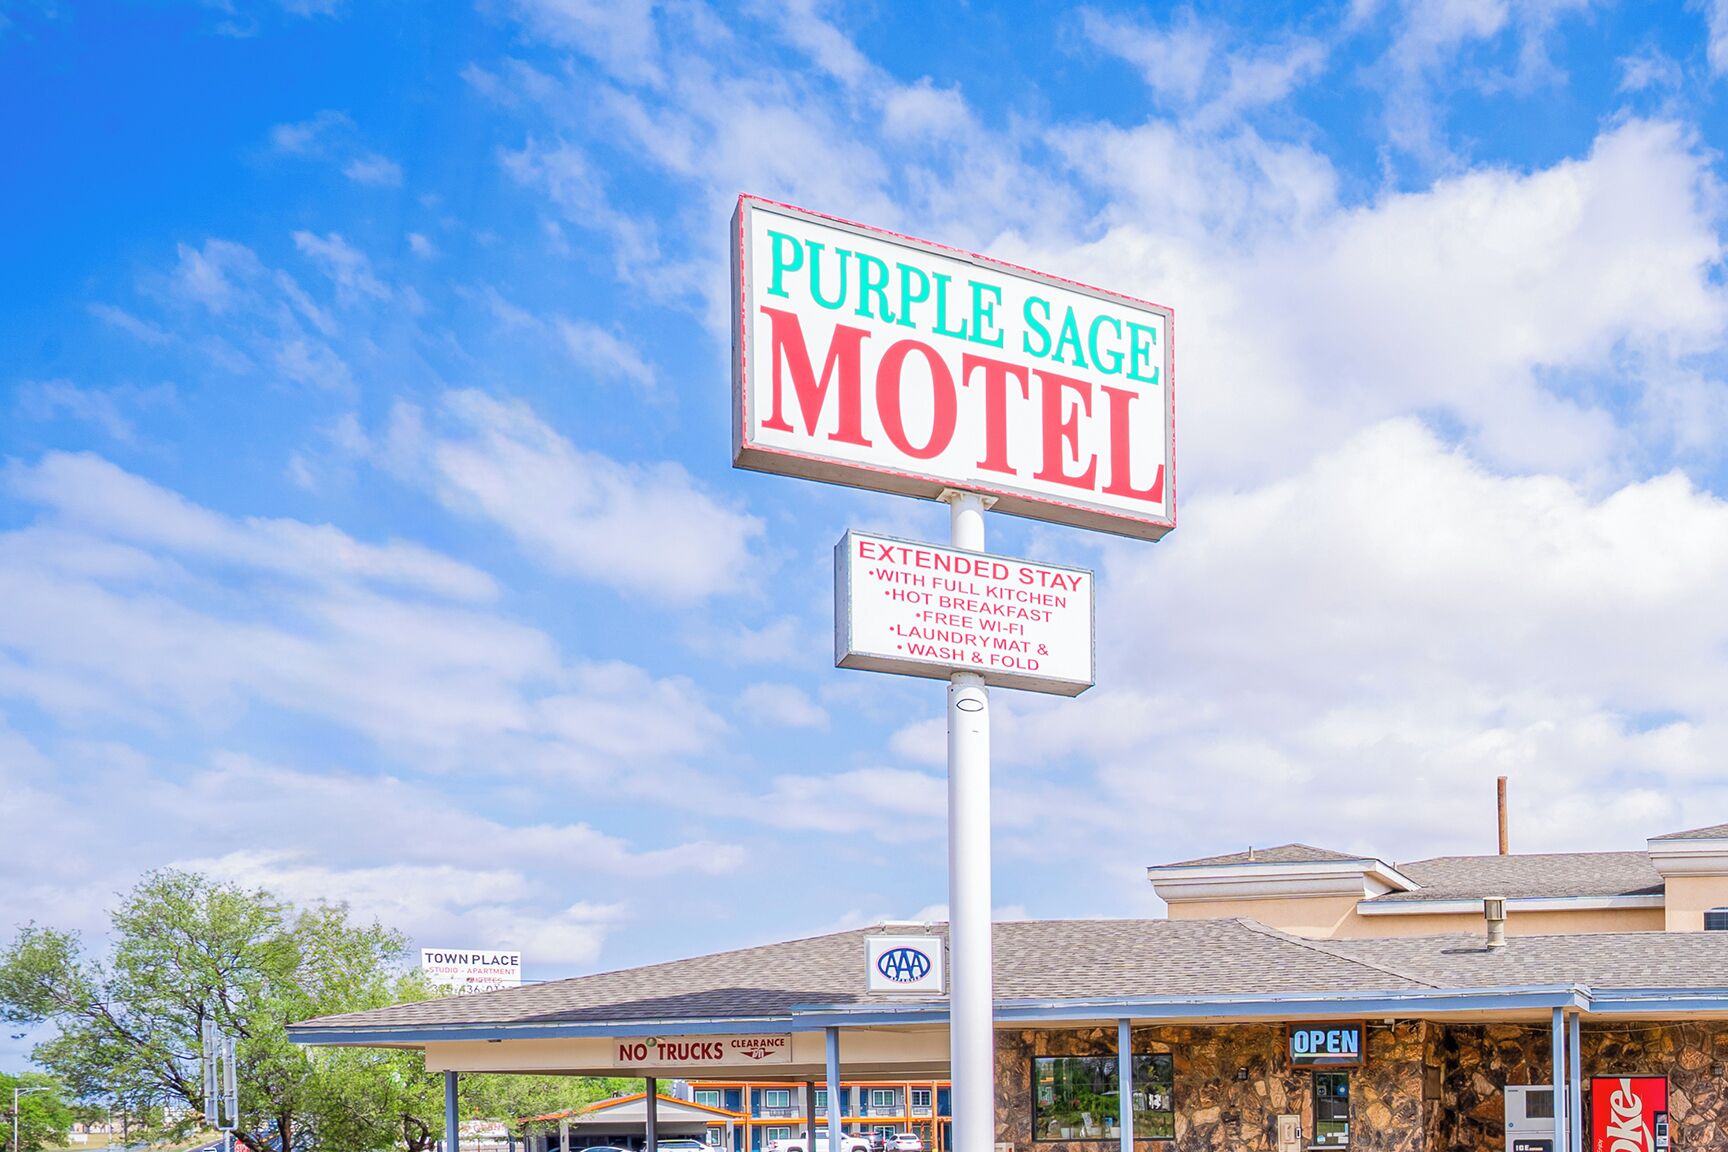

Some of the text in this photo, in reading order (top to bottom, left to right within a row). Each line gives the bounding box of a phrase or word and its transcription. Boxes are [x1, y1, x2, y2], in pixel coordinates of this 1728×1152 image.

[767, 229, 1160, 386] PURPLE SAGE
[760, 305, 1165, 504] MOTEL
[859, 540, 1083, 593] EXTENDED STAY
[875, 567, 1067, 609] WITH FULL KITCHEN
[892, 588, 1053, 623] HOT BREAKFAST
[923, 610, 1025, 636] FREE WI-FI
[907, 642, 1040, 671] WASH & FOLD
[1037, 643, 1049, 656] &
[425, 952, 519, 966] TOWN PLACE
[428, 966, 459, 974] STUDIO
[467, 967, 516, 976] APARTMENT
[884, 949, 926, 980] AAA
[619, 1038, 785, 1061] NO TRUCKS CLEARANCE
[1294, 1030, 1359, 1054] OPEN
[1515, 1144, 1530, 1152] ICE
